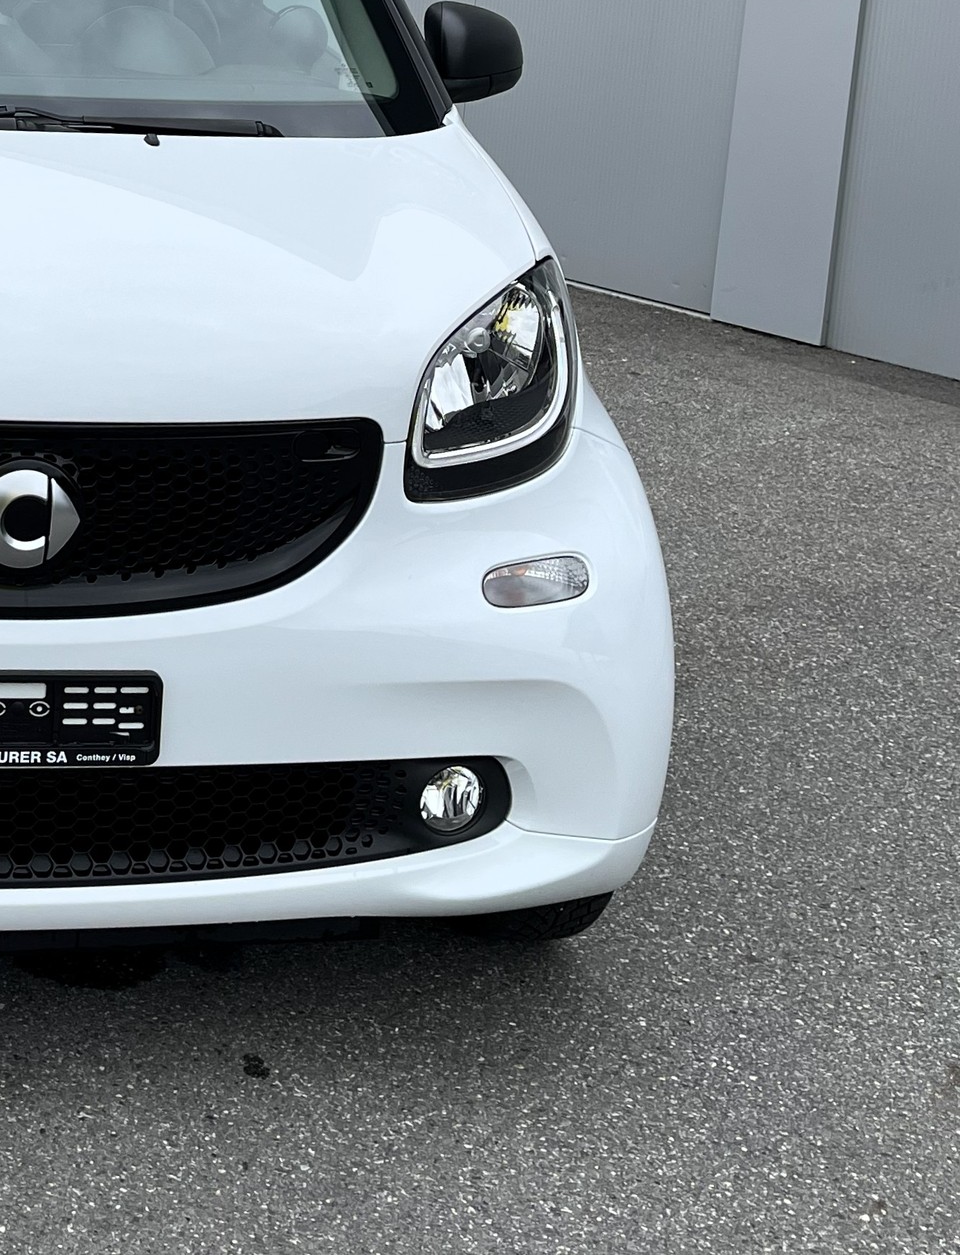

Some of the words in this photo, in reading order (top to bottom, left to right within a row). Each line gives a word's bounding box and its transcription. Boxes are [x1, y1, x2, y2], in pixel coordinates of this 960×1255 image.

[46, 750, 68, 764] SA
[76, 753, 111, 763] Conthey
[118, 753, 136, 762] Visp
